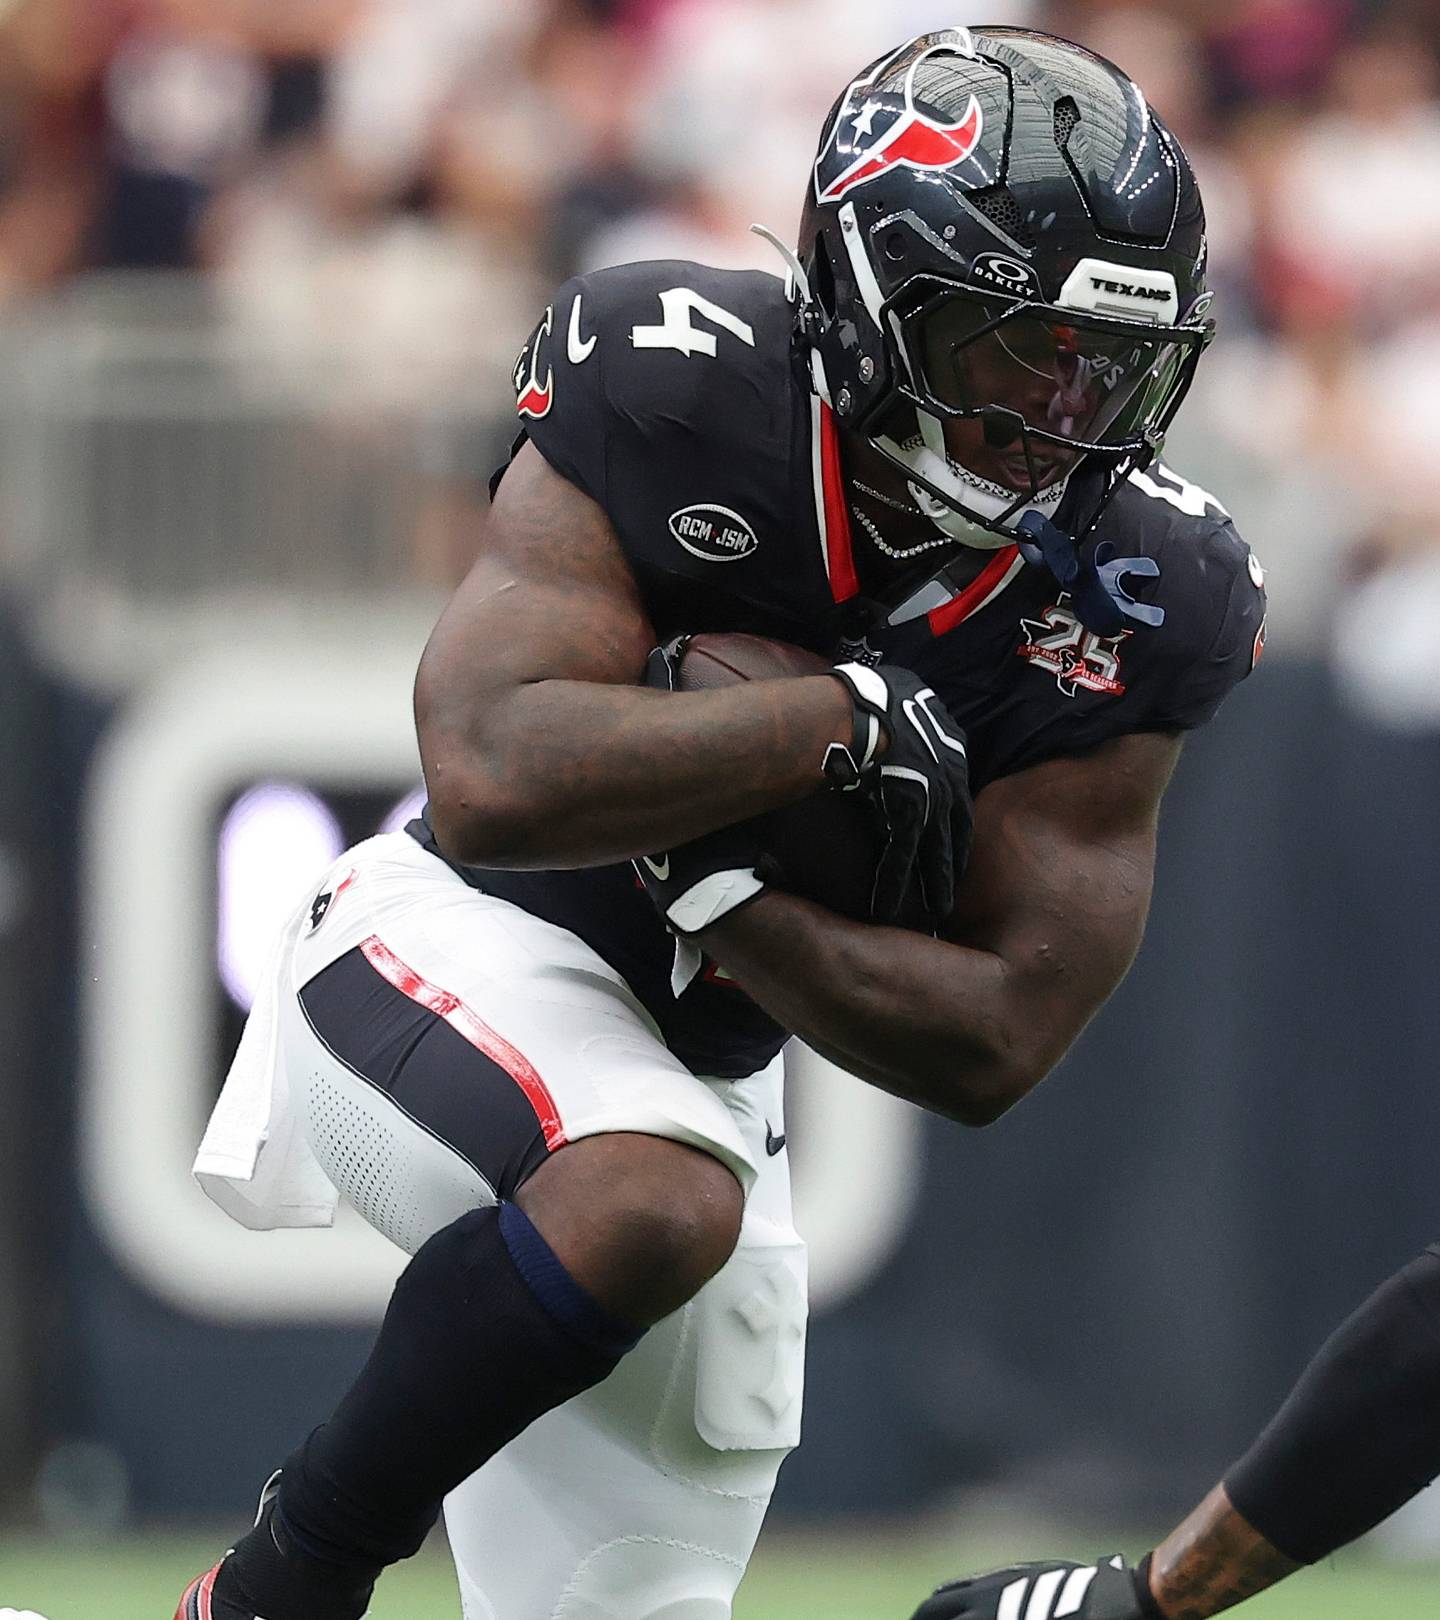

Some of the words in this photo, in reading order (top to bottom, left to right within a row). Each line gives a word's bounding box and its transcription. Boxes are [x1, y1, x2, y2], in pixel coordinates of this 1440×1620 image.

[974, 266, 1036, 297] OAKLEY
[1090, 277, 1172, 302] TEXANS
[631, 287, 756, 358] 4
